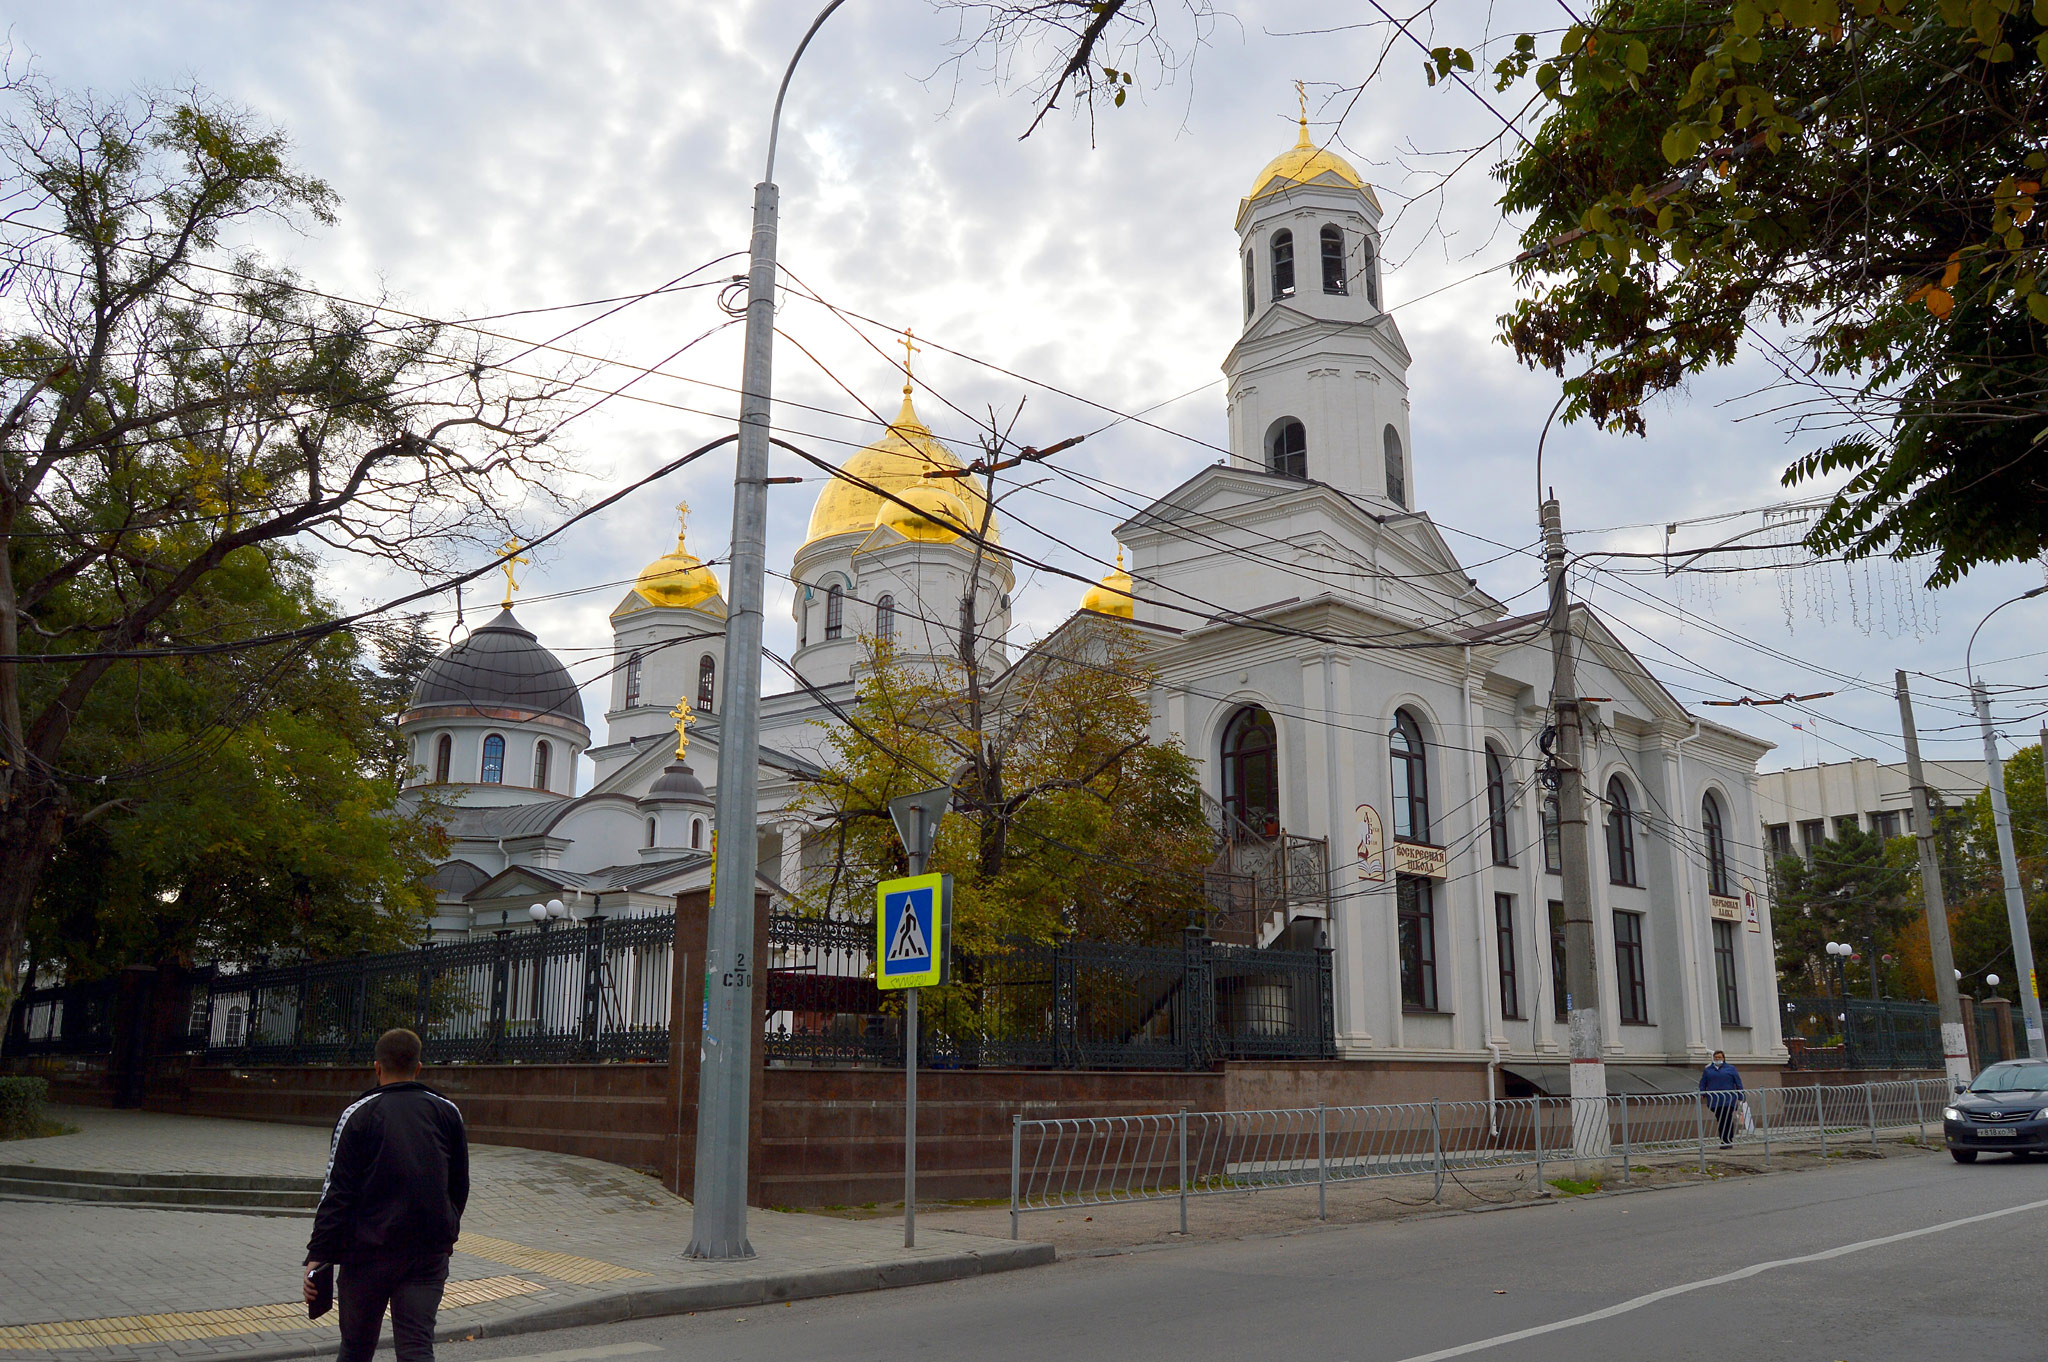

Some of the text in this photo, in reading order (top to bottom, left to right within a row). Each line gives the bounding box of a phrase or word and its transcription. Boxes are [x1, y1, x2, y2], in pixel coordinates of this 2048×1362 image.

[1396, 846, 1444, 863] ВОСКРЕСНАЯ
[1407, 859, 1435, 873] ШКОЛА
[737, 952, 745, 967] 2
